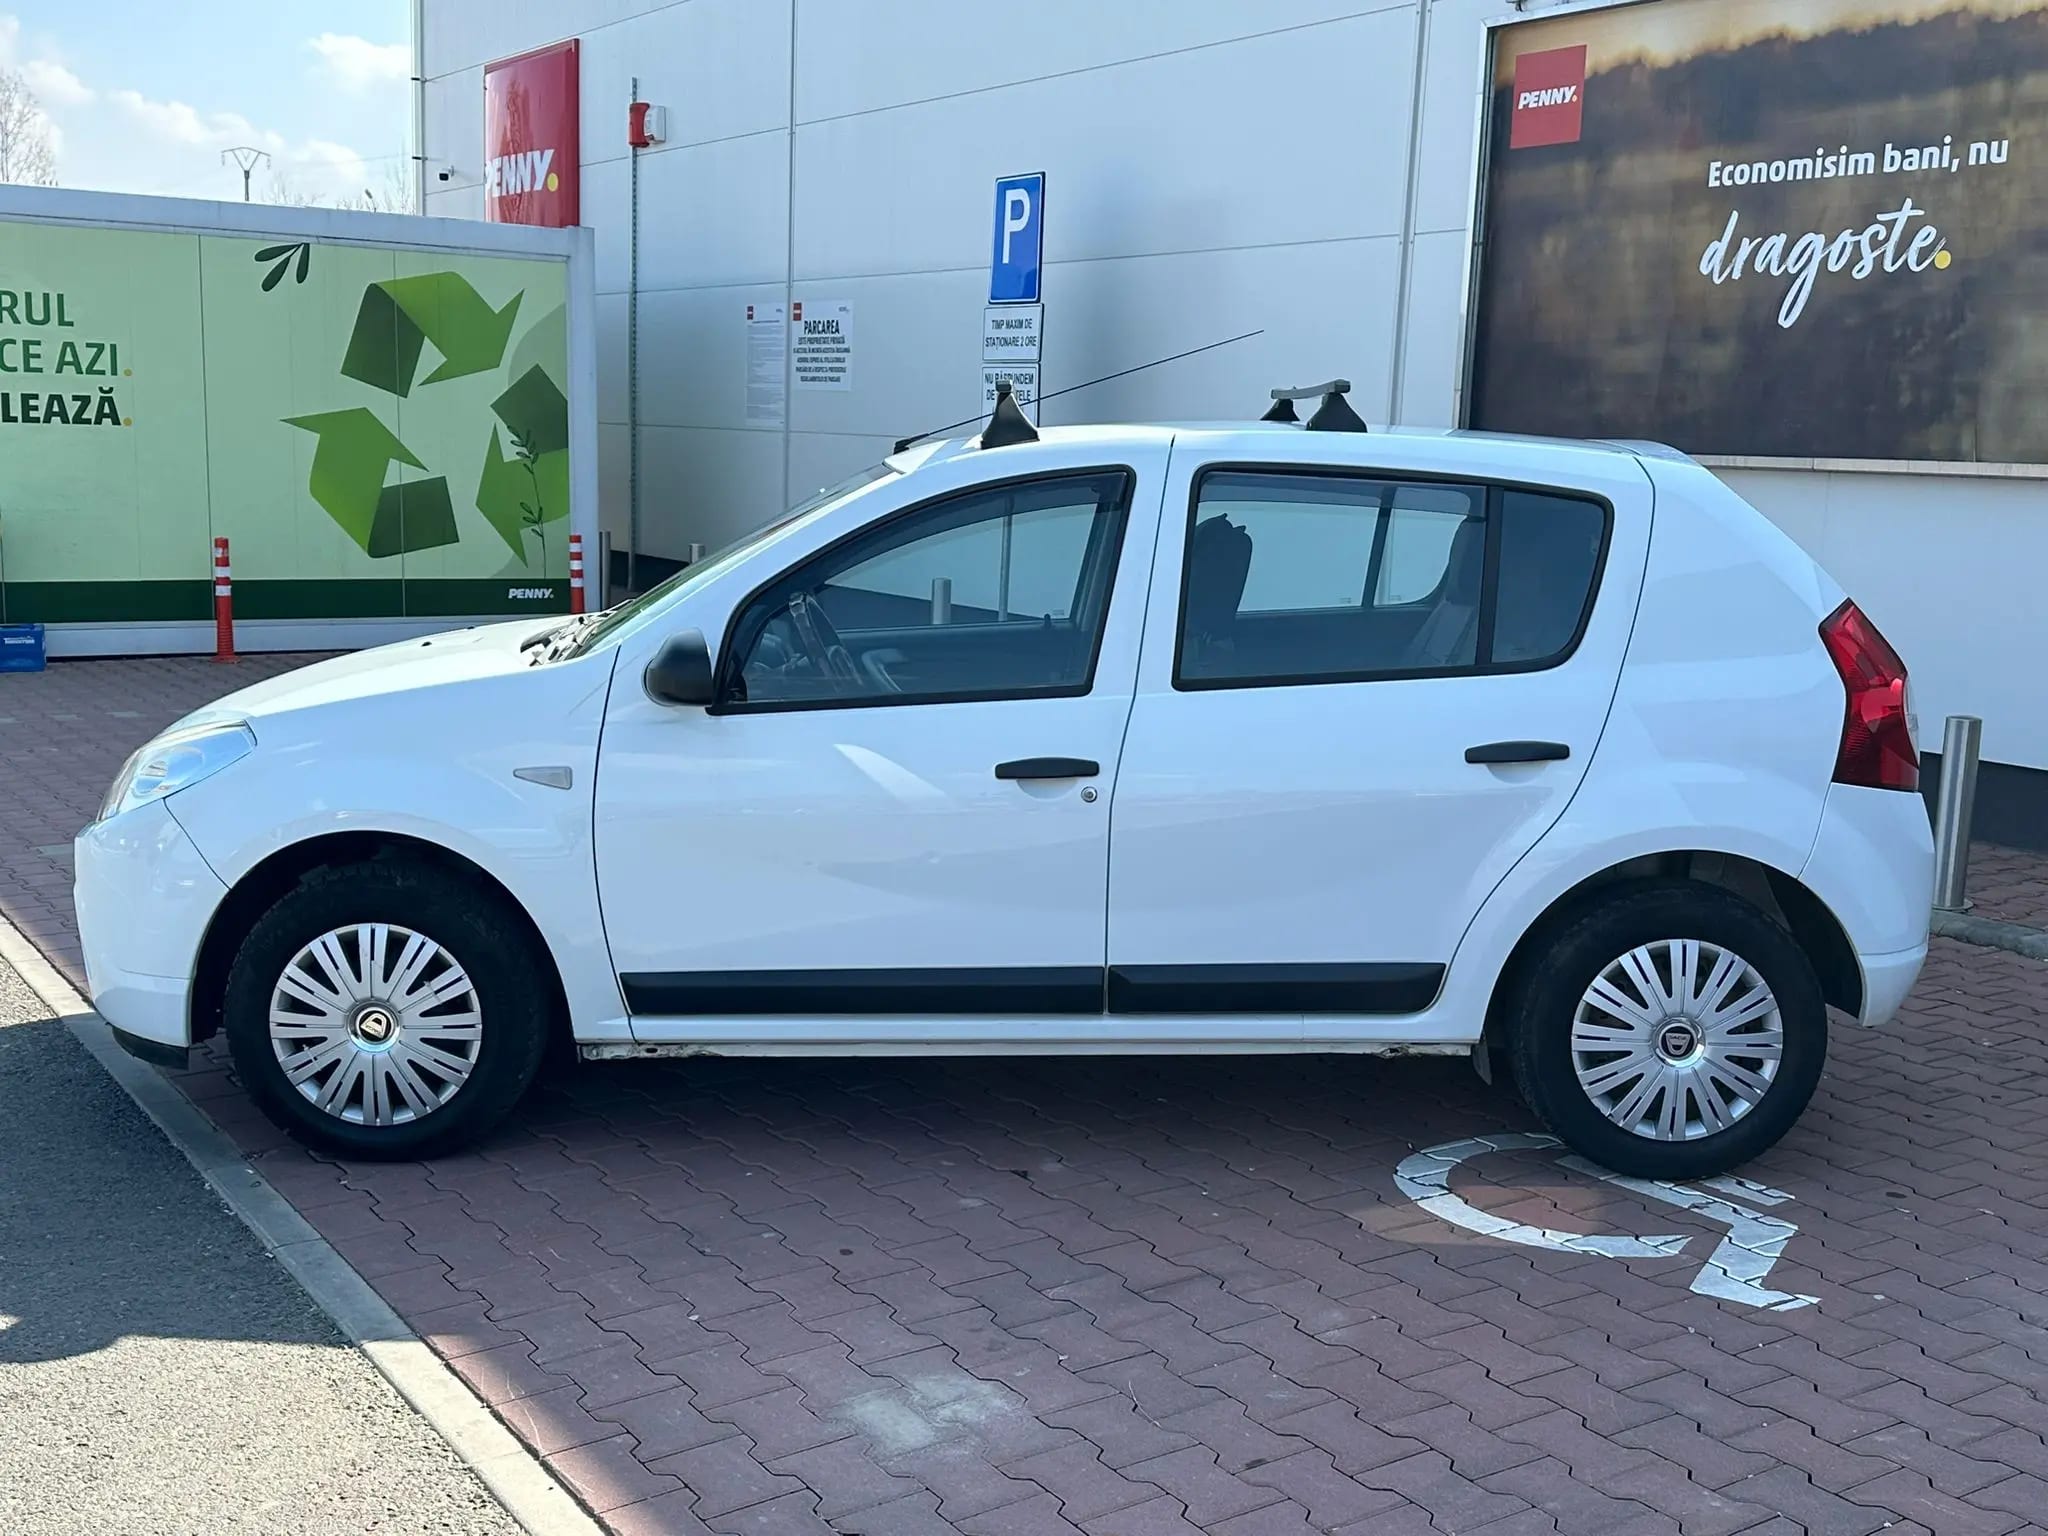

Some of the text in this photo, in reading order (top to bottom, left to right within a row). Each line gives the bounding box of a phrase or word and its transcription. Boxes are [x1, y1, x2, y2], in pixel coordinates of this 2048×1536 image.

[1708, 136, 2009, 187] Economisim bani, nu
[1002, 188, 1030, 264] P
[1699, 198, 1952, 329] dragoste.
[804, 319, 840, 335] PARCAREA
[992, 318, 1033, 330] TIMP MAXIM DE
[1020, 336, 1025, 347] 2
[1025, 335, 1037, 347] ORE
[985, 373, 994, 384] NU
[986, 389, 995, 401] DE
